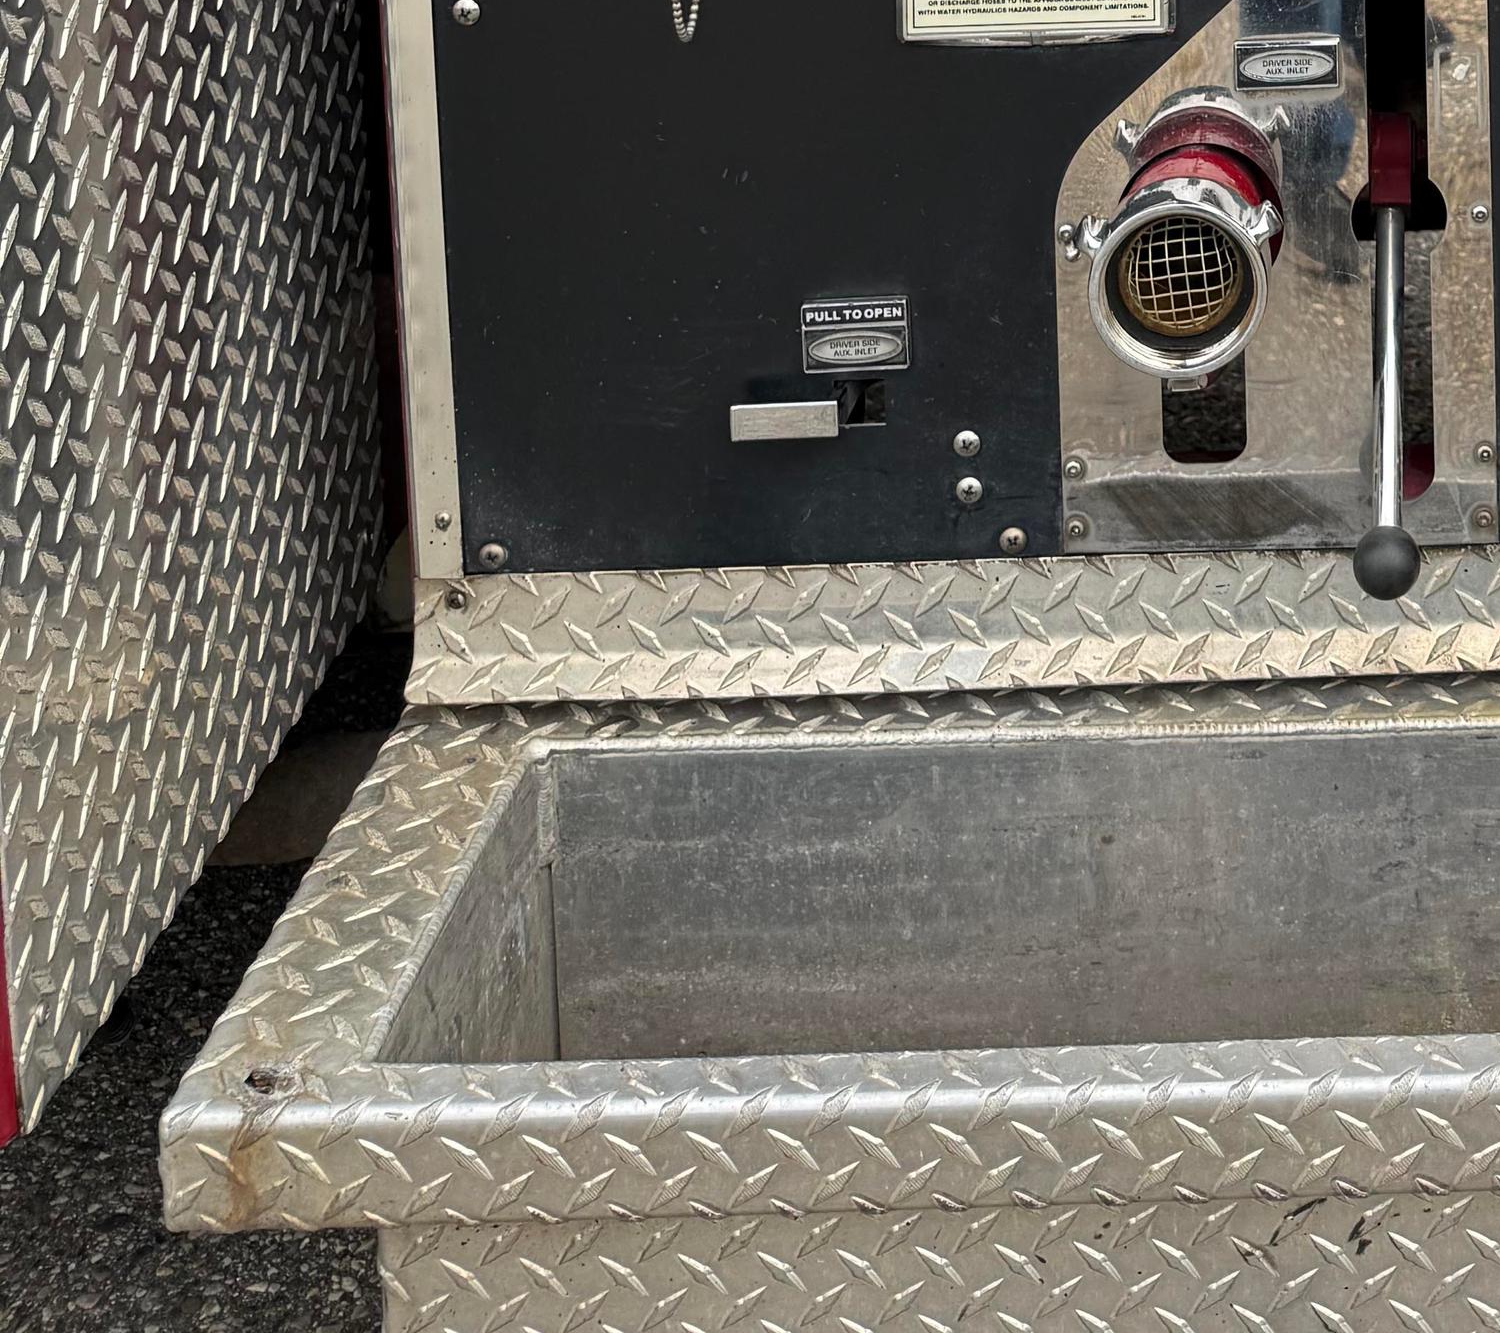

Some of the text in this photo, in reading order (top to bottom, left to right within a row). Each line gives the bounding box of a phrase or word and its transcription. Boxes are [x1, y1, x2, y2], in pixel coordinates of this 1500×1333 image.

[1262, 58, 1313, 68] DRIVER SIDE
[1286, 67, 1309, 75] INLET
[805, 306, 902, 323] PULL TO OPEN
